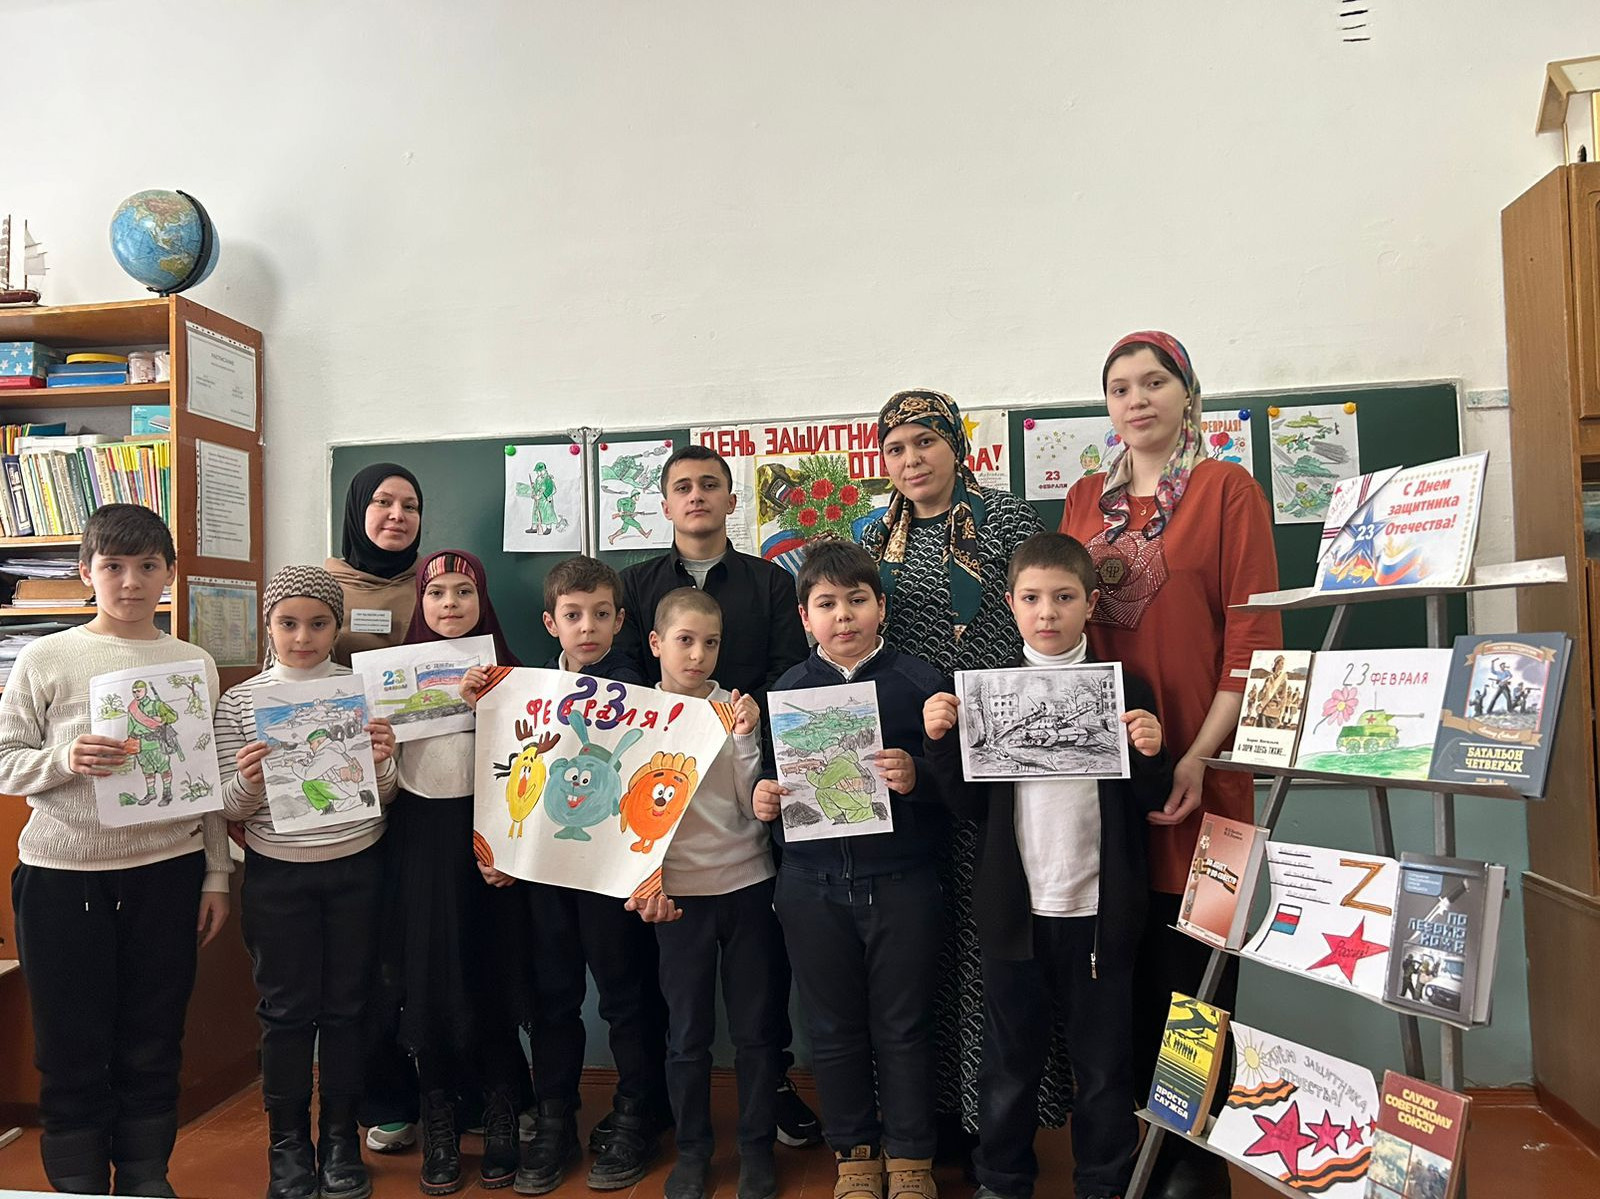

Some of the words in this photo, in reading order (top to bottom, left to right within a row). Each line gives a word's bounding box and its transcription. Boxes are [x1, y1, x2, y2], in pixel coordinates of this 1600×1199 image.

[700, 429, 755, 457] ДЕНЬ
[764, 422, 878, 454] ЗАЩИТНИ
[1045, 470, 1061, 481] 23
[1403, 482, 1412, 496] С
[1413, 478, 1451, 497] Днем
[1388, 495, 1460, 516] защитника
[1356, 524, 1375, 541] 23
[1385, 514, 1457, 536] Отечества!
[382, 669, 406, 686] 23
[1343, 662, 1370, 687] 23
[1370, 671, 1430, 686] ФЕВРАЛЯ
[557, 676, 627, 730] 23
[1467, 747, 1524, 761] БАТАЛЬОН
[1465, 758, 1523, 773] ЧЕТВЕРЫХ
[1447, 912, 1467, 926] ПО
[1154, 1093, 1188, 1119] СЛУЖБА
[1156, 1084, 1189, 1109] ПРОСТО
[1402, 1088, 1439, 1111] СЛУЖУ
[1385, 1093, 1453, 1130] СОВЕТСКОМУ
[1398, 1111, 1436, 1135] СОЮЗУ
